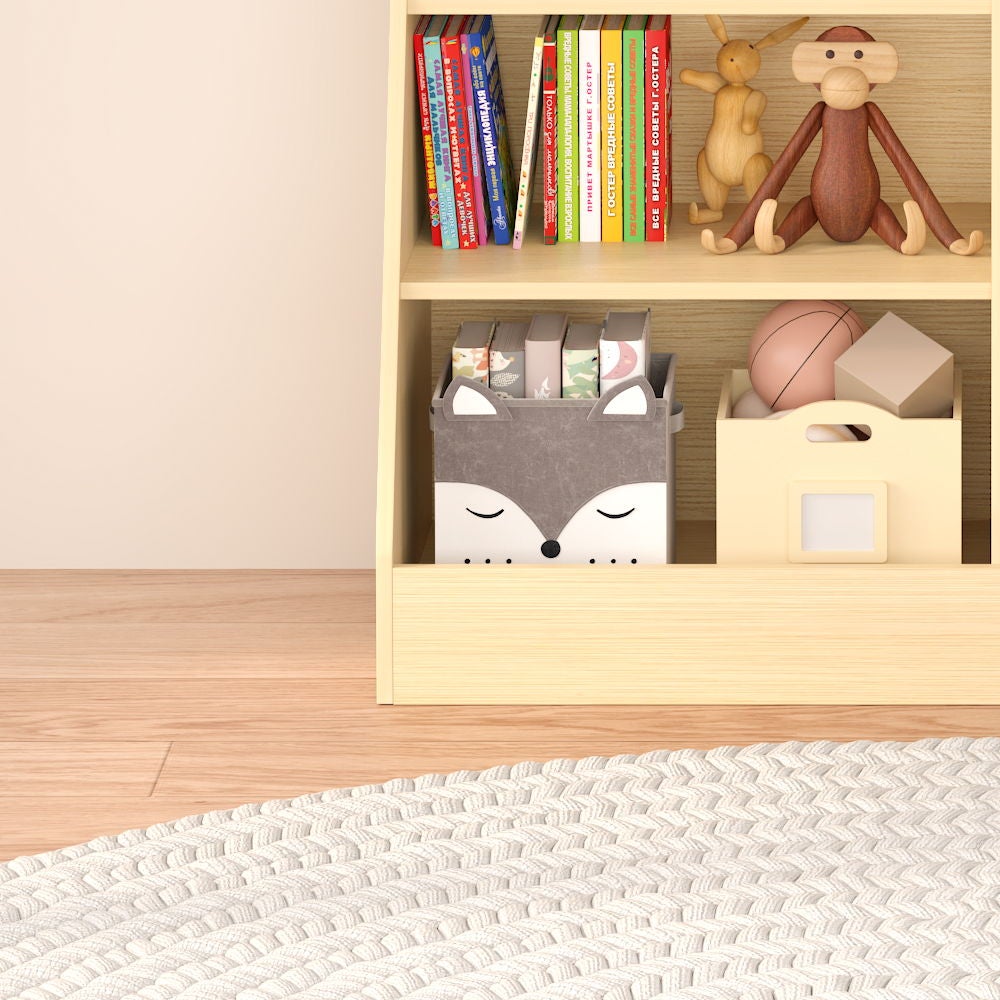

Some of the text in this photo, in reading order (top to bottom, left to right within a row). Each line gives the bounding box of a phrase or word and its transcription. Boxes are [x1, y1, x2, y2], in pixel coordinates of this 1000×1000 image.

[562, 31, 571, 64] ВРЕДНЫЕ
[607, 62, 615, 111] СОВЕТЫ
[477, 89, 493, 166] ЭНЦИКЛОПЕДИЯ
[608, 114, 616, 169] ВРЕДНЫЕ
[607, 171, 615, 207] ОСТЕР
[652, 150, 660, 201] ВРЕДНЫЕ
